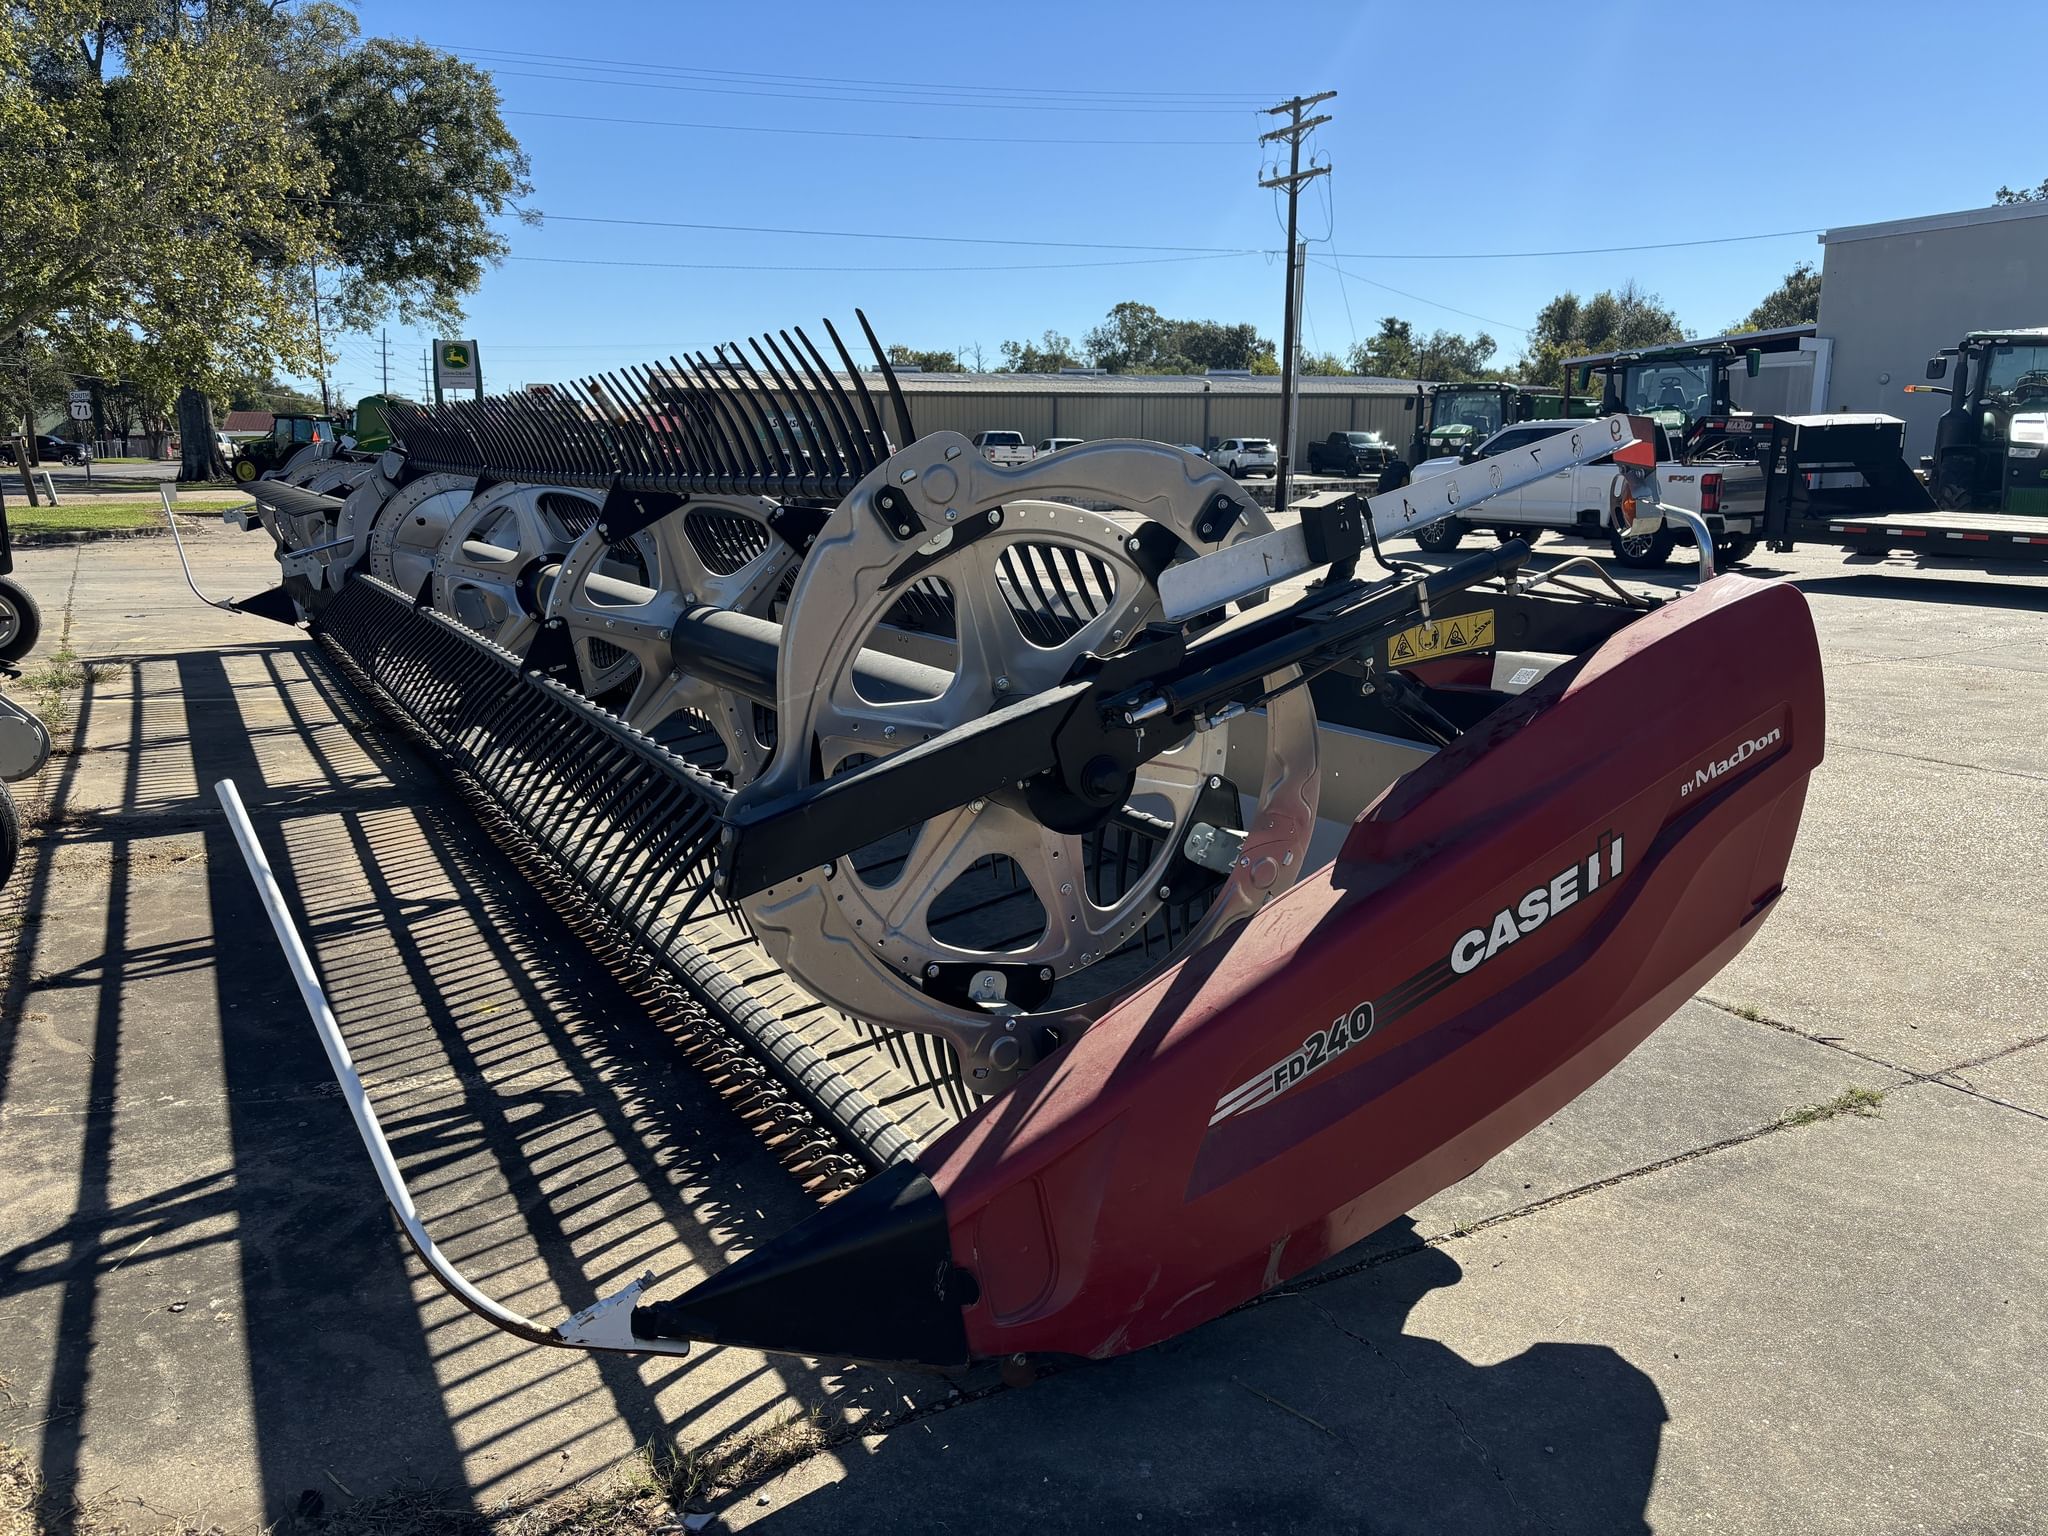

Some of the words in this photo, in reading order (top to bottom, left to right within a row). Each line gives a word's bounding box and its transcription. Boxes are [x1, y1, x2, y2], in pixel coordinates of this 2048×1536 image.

[74, 405, 88, 416] 71
[1681, 780, 1694, 798] BY
[1695, 726, 1781, 788] MacDon
[1450, 862, 1579, 975] CASE
[1272, 999, 1375, 1095] FD240
